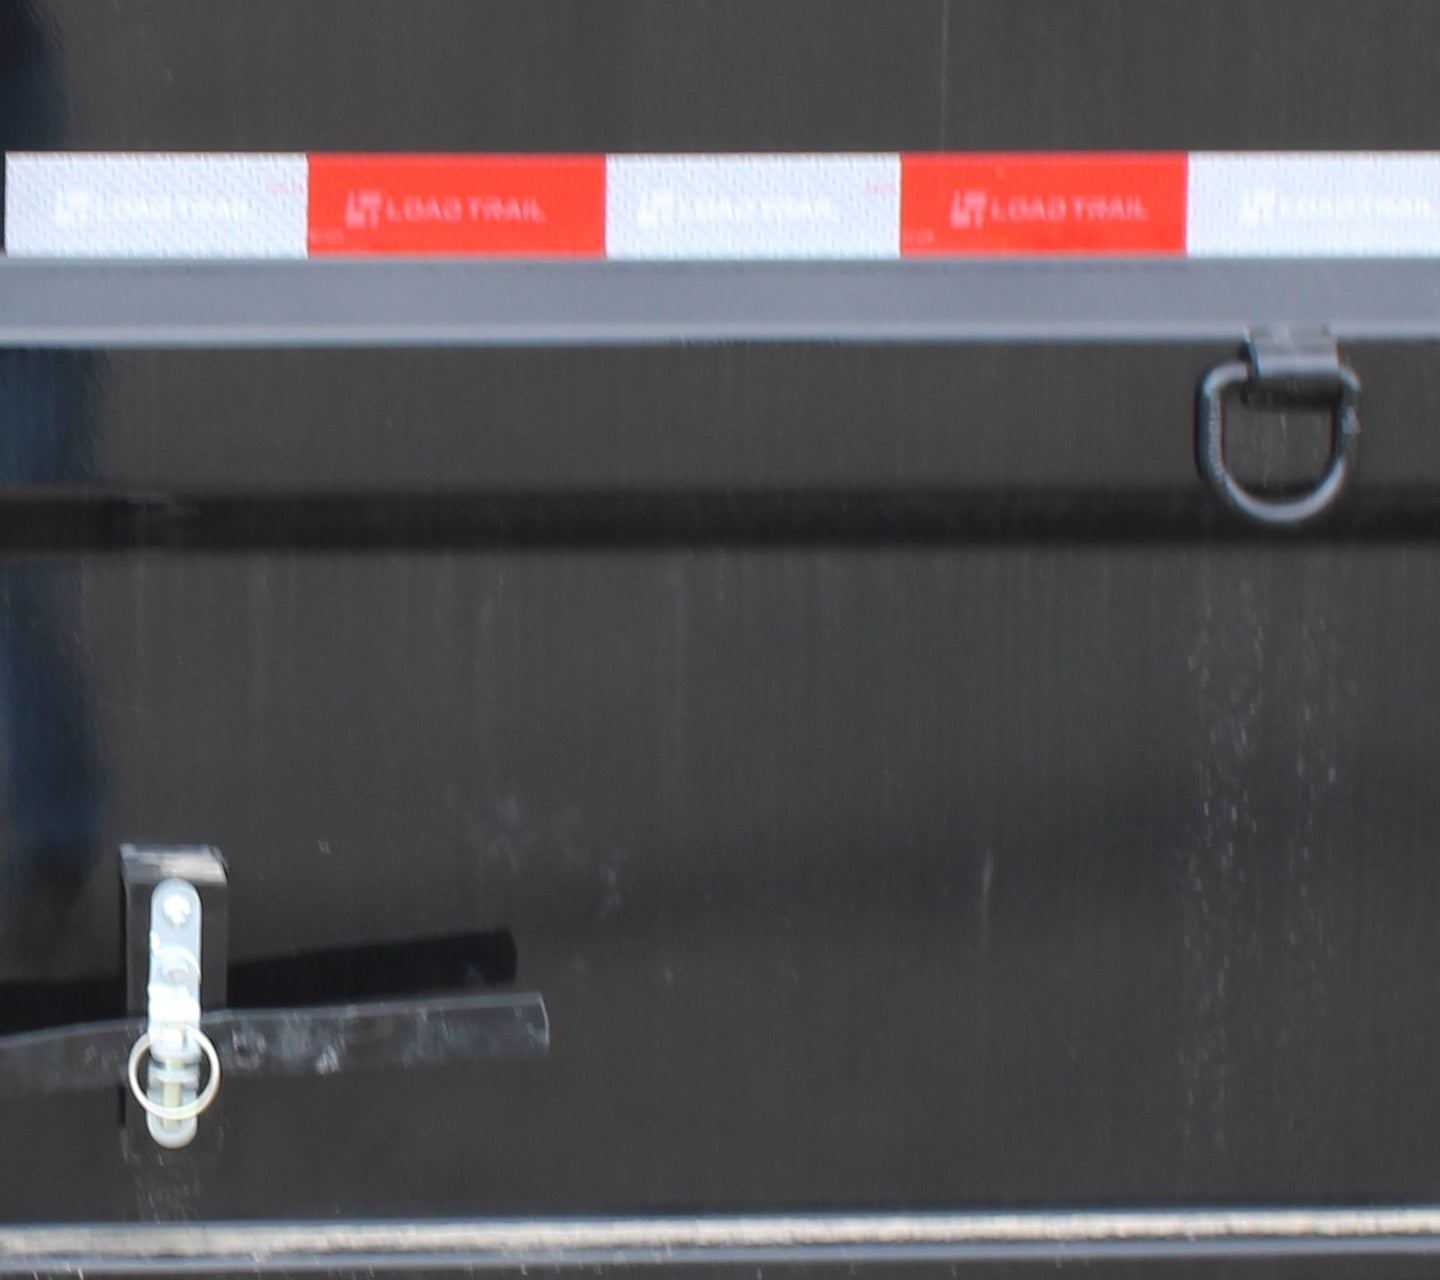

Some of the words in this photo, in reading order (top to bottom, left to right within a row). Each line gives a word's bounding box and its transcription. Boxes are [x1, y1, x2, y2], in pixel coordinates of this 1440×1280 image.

[386, 200, 463, 225] LOAD
[468, 200, 546, 224] TRAIL
[992, 199, 1066, 223] LOAD
[1072, 199, 1149, 223] TRAIL
